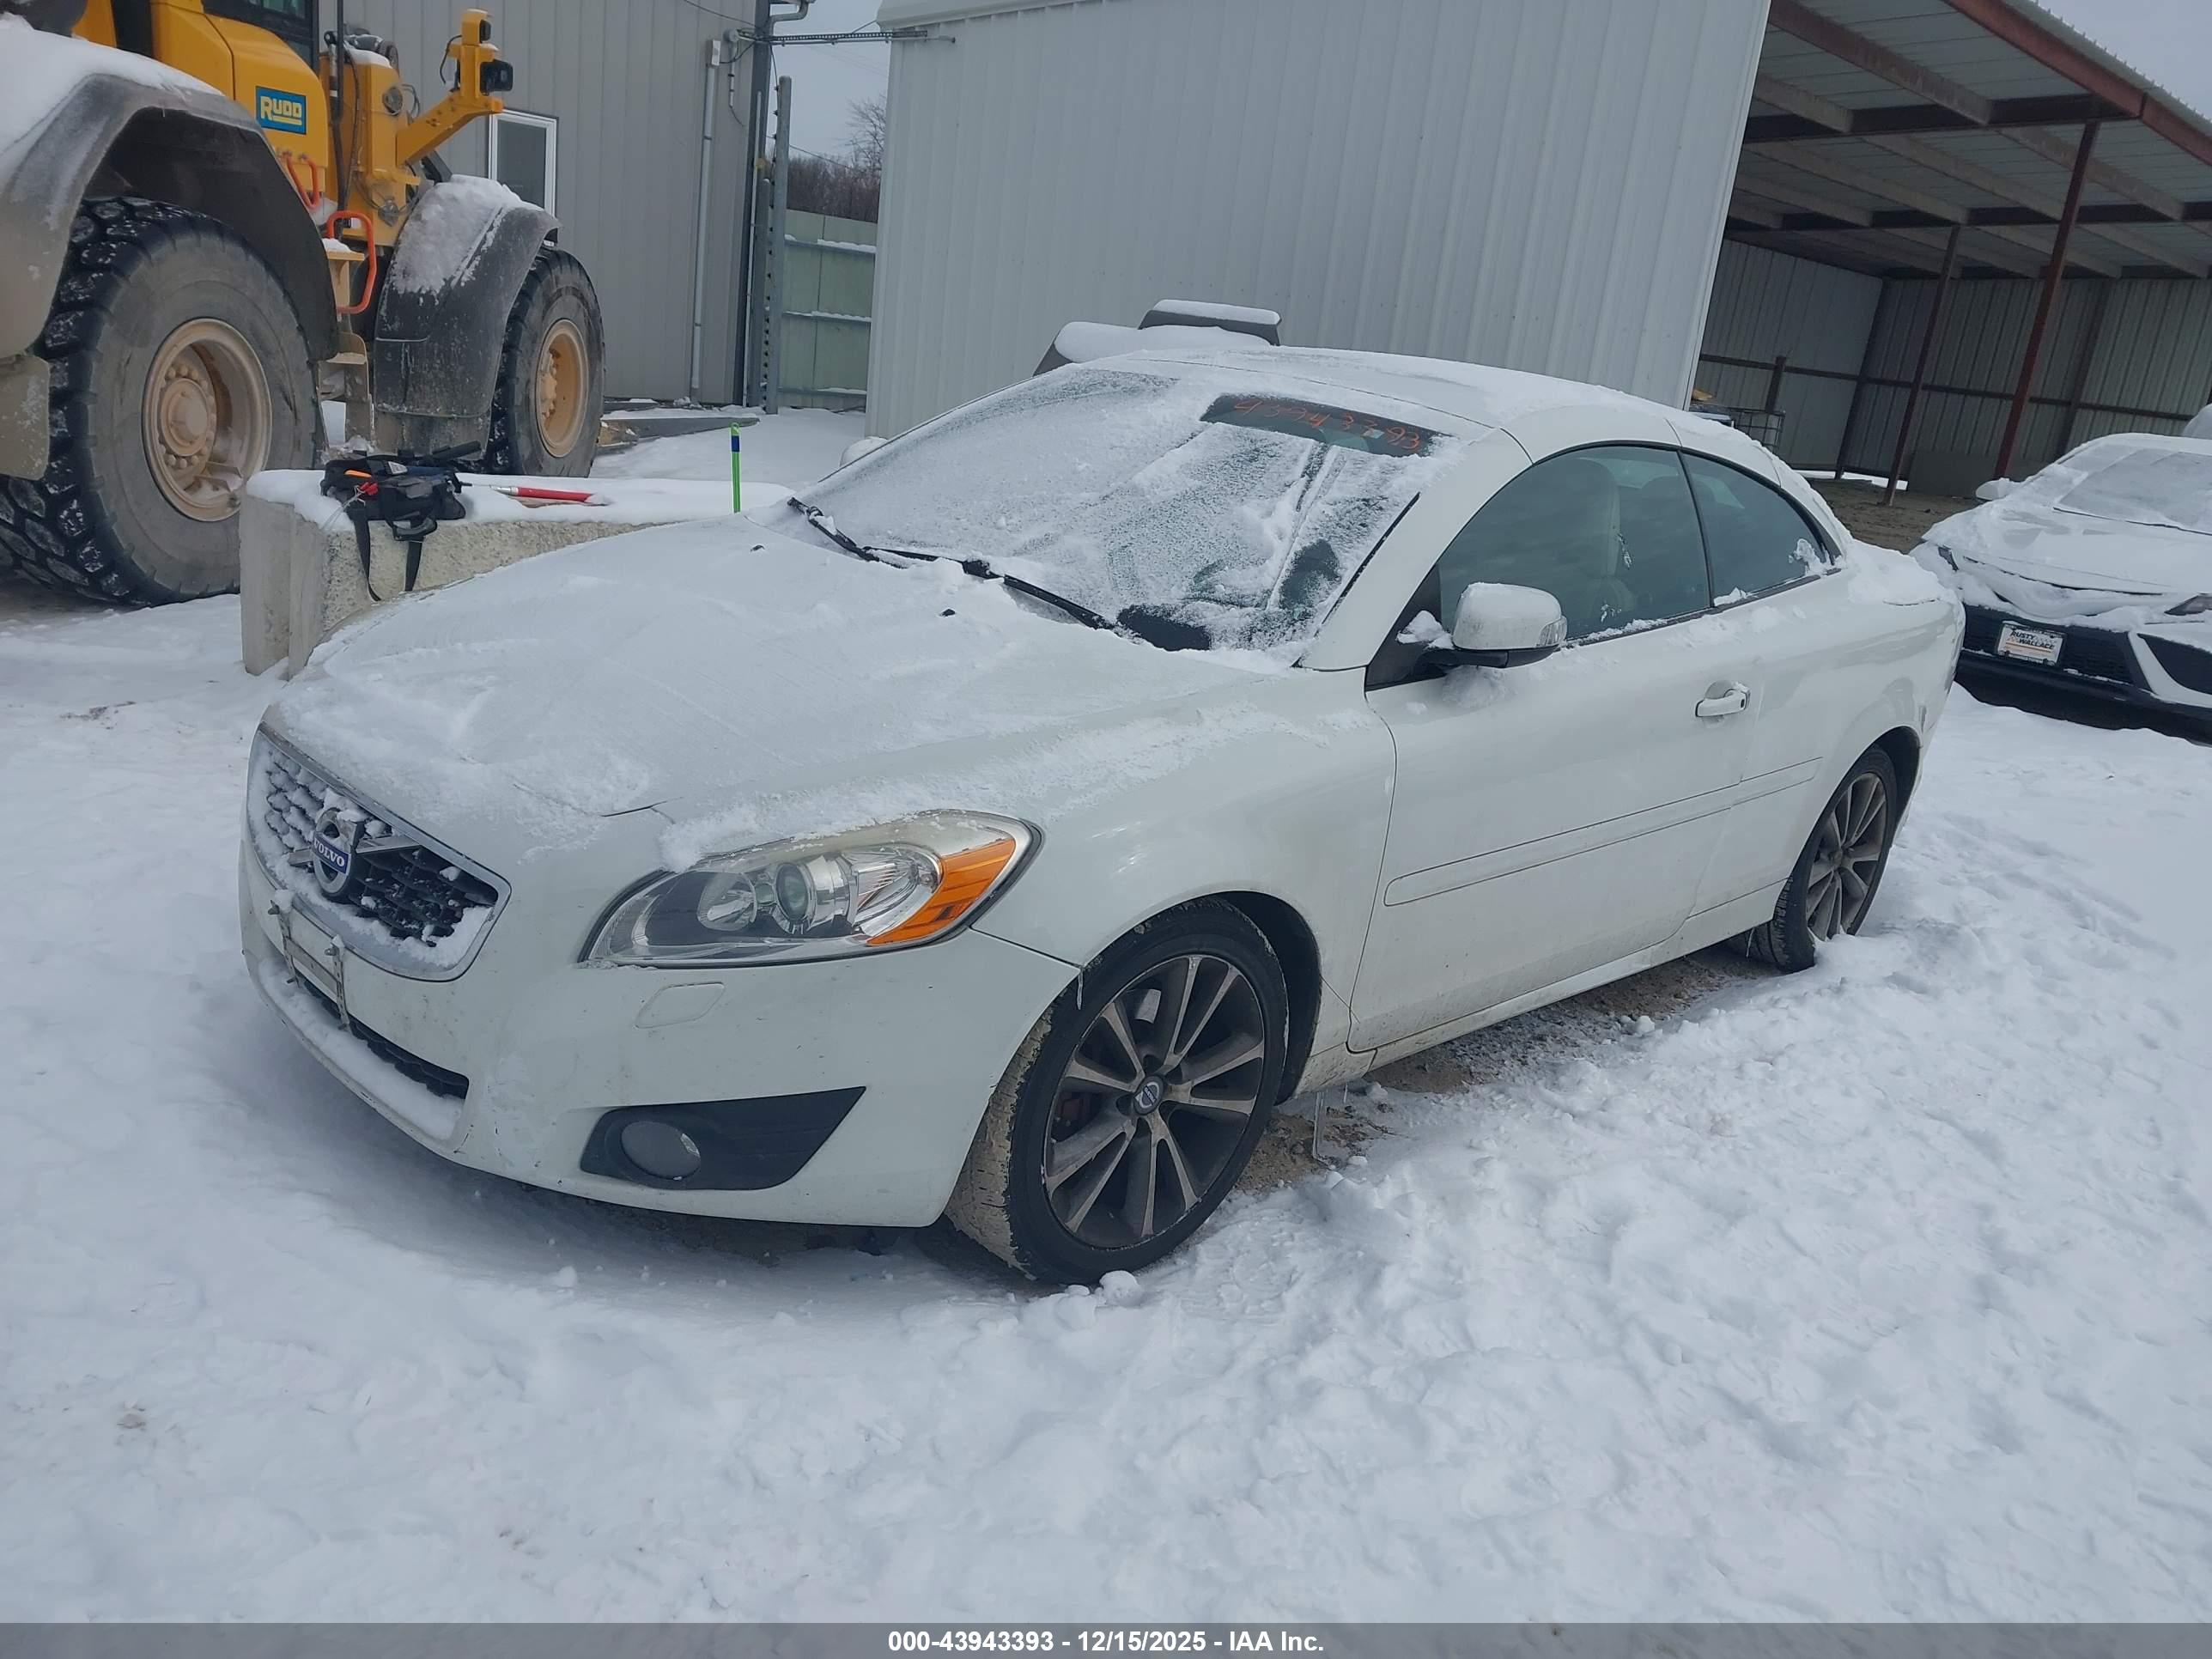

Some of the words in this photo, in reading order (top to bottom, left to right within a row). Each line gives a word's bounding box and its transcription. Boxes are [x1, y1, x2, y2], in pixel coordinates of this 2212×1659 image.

[260, 95, 302, 121] RUDD
[2010, 630, 2036, 640] RUSTY
[2019, 638, 2055, 649] WALLACE
[313, 837, 345, 867] VOLVO
